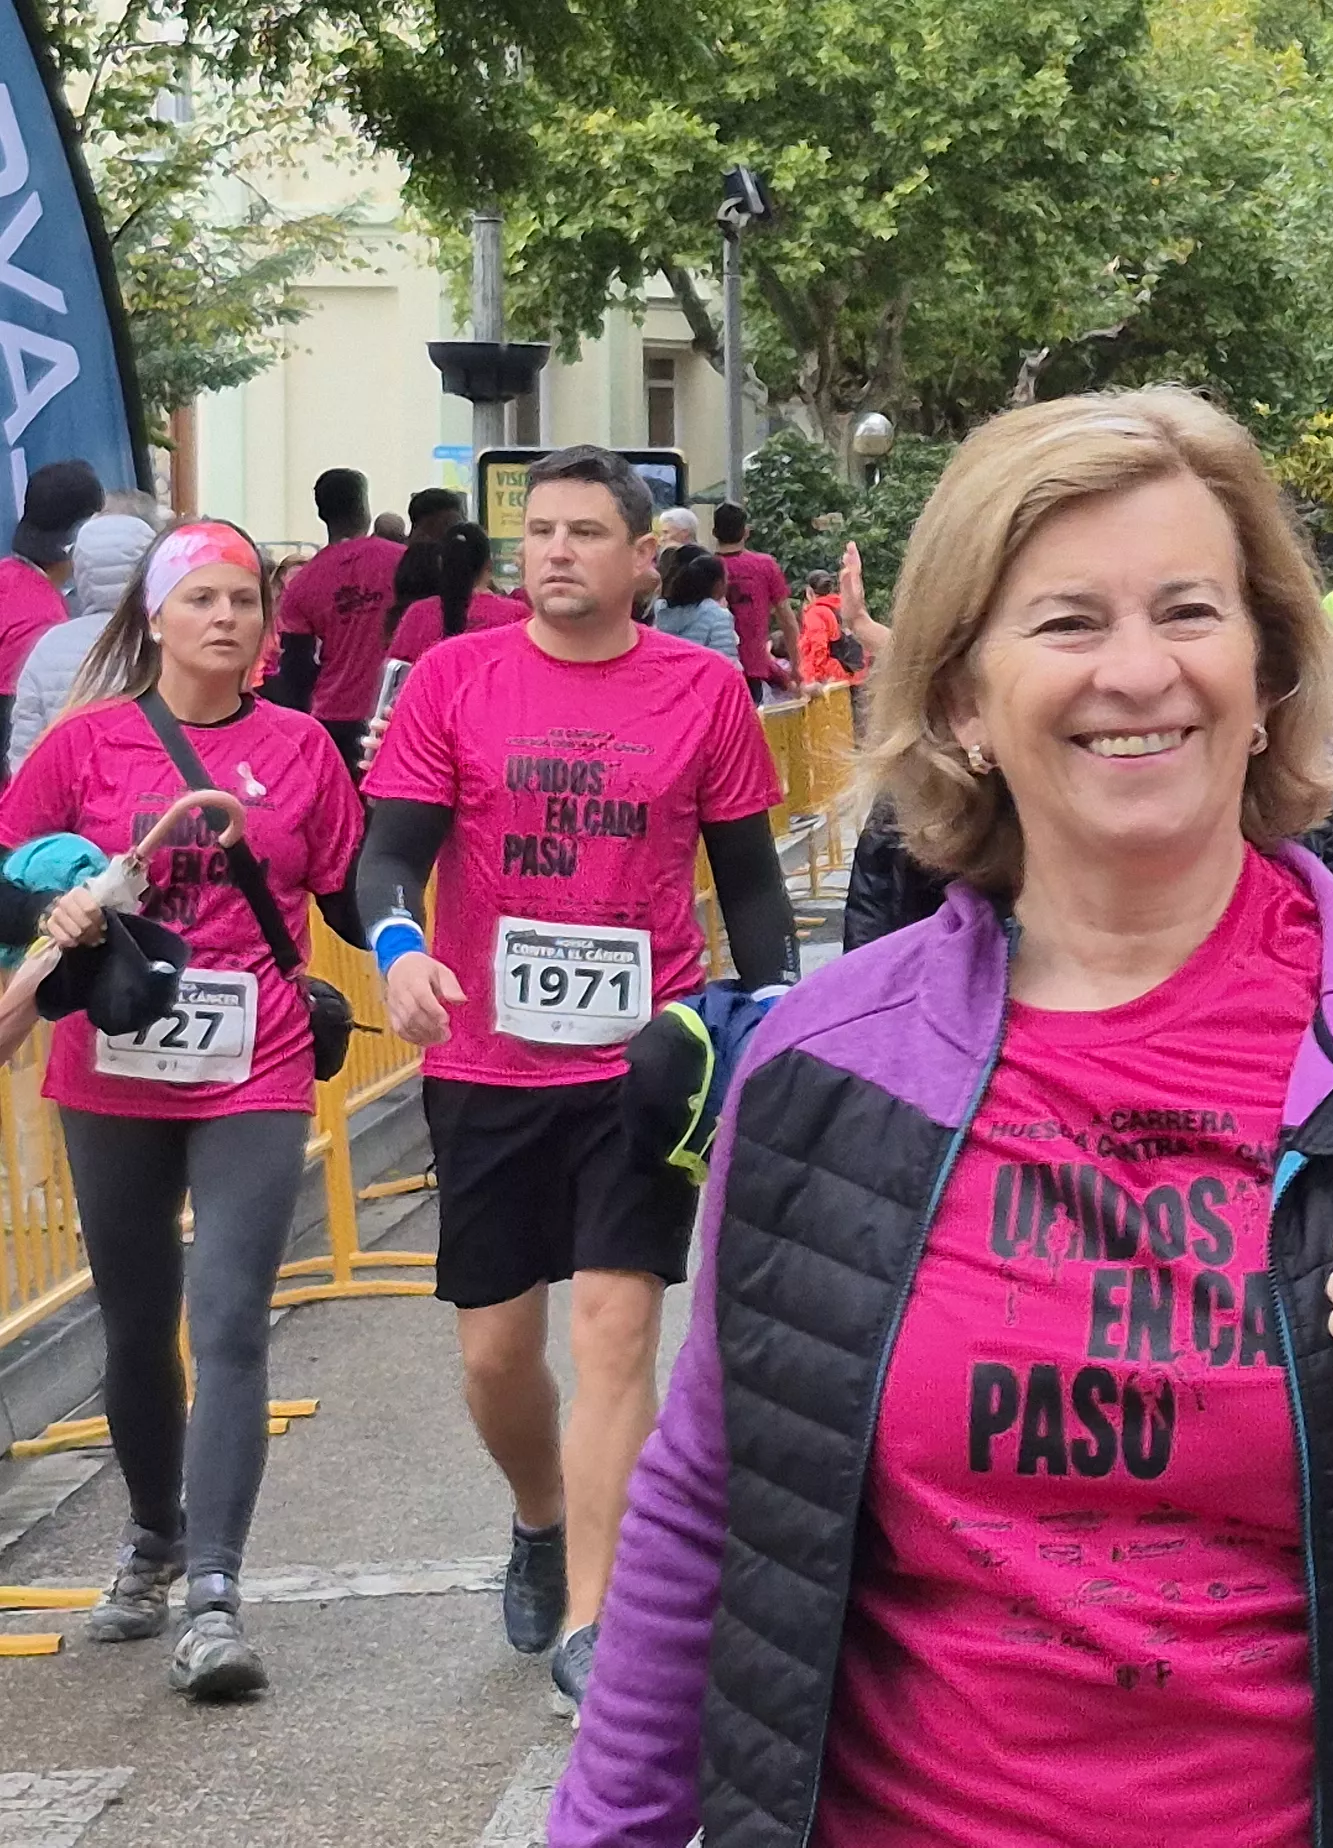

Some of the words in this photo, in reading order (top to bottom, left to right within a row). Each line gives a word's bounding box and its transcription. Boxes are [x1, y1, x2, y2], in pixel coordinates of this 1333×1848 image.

[505, 754, 606, 796] UNIDOS
[545, 796, 578, 835] EN
[502, 833, 578, 878] PASO
[512, 942, 566, 960] CONTRA
[510, 962, 631, 1012] 1971
[1110, 1108, 1239, 1134] CARRERA
[990, 1162, 1235, 1268] UNIDOS
[1086, 1267, 1177, 1362] EN
[969, 1362, 1176, 1481] PASO
